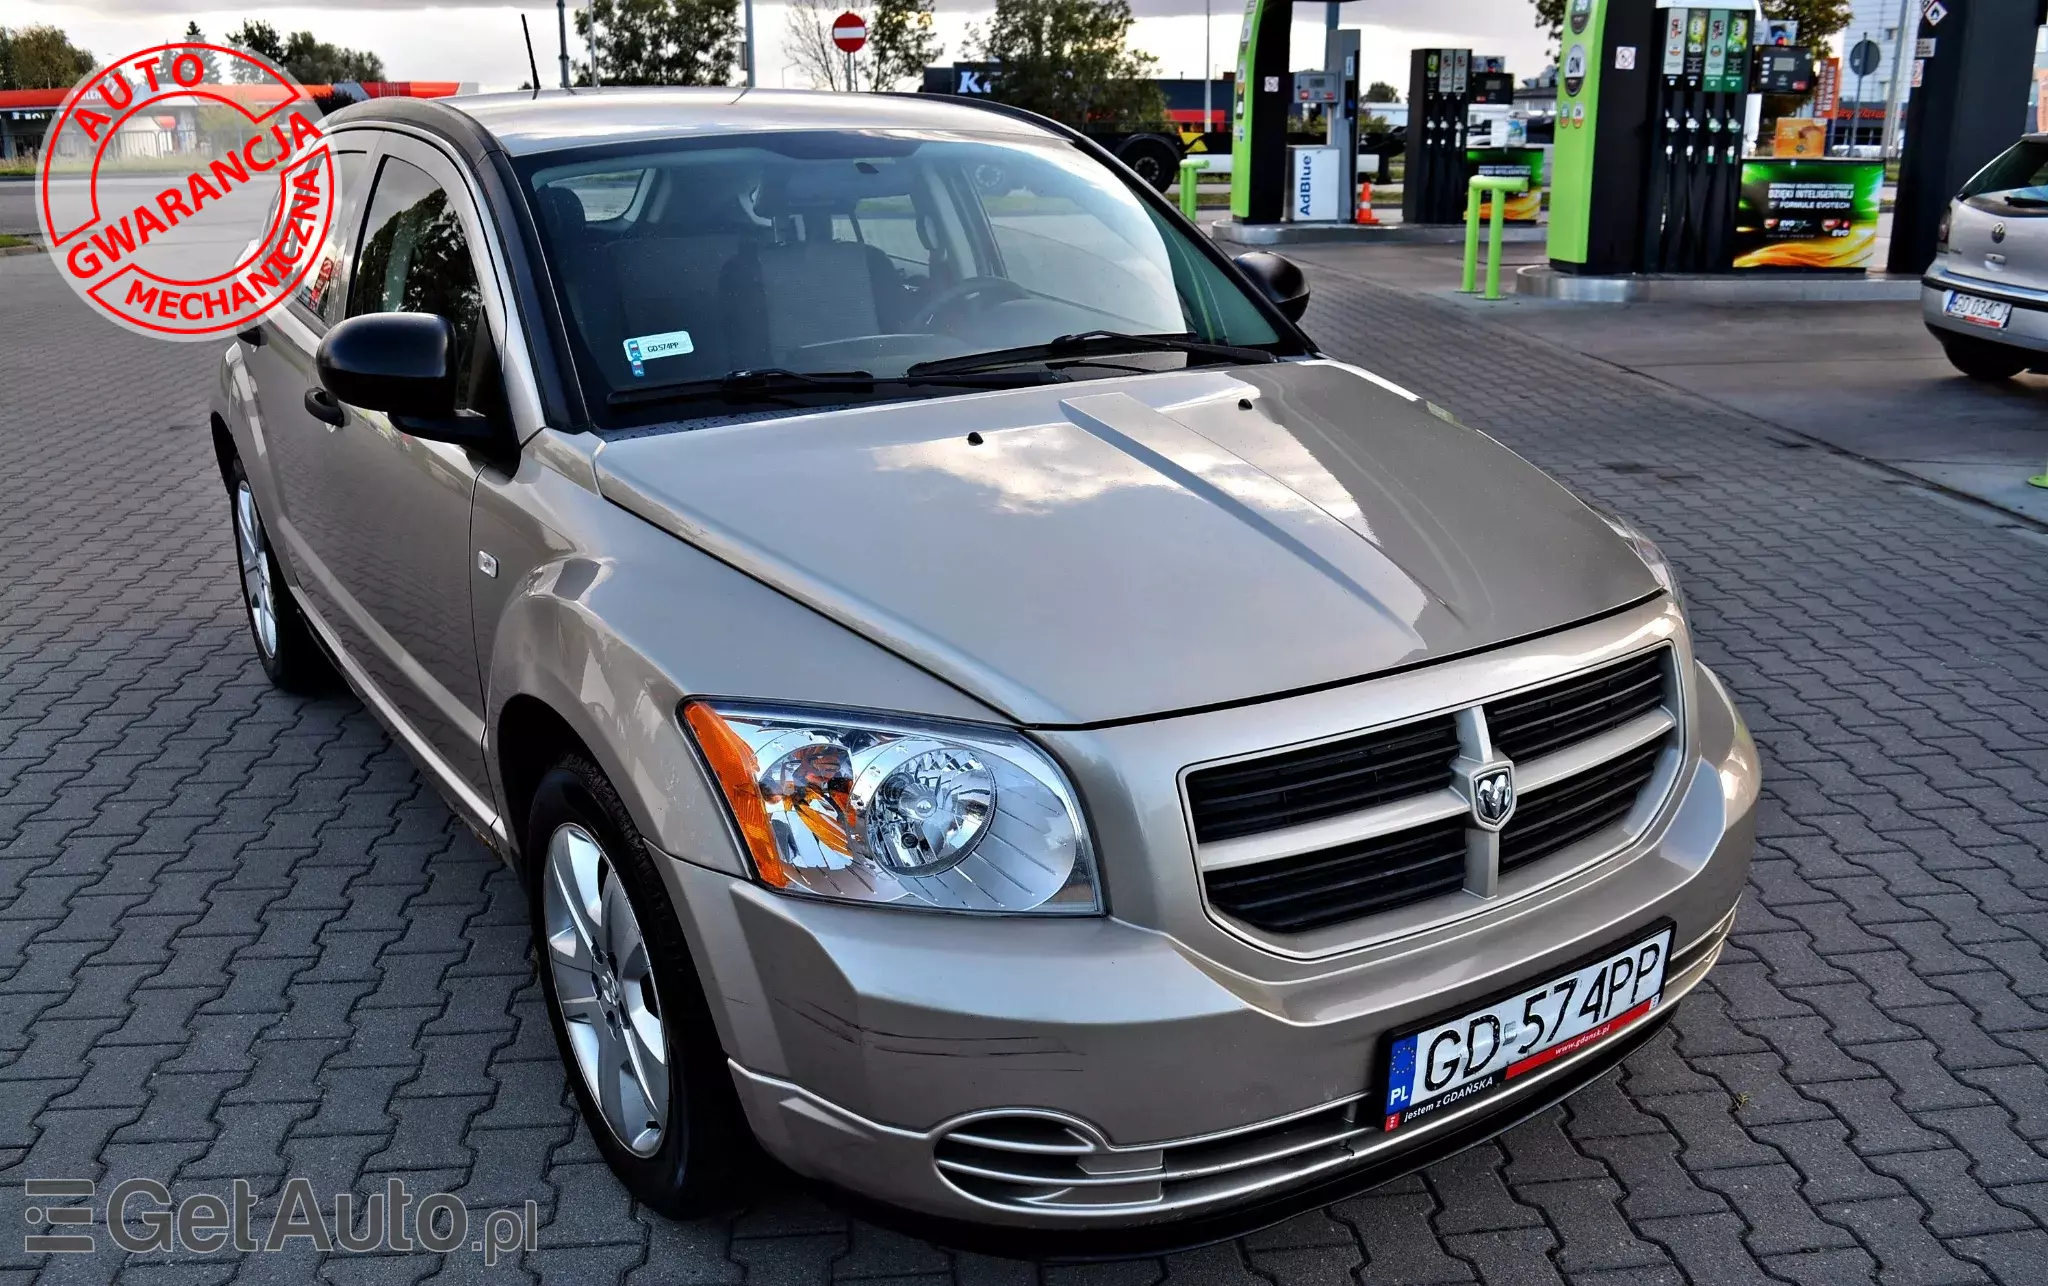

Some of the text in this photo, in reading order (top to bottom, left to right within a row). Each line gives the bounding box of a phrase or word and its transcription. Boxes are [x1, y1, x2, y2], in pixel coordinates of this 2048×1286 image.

[1299, 155, 1312, 216] AdBlue
[1424, 942, 1661, 1092] GD 574PP
[1555, 1024, 1610, 1055] www.gdansk.pl
[1389, 1085, 1409, 1106] PL
[1404, 1076, 1493, 1123] jestem z GDAŃSKA
